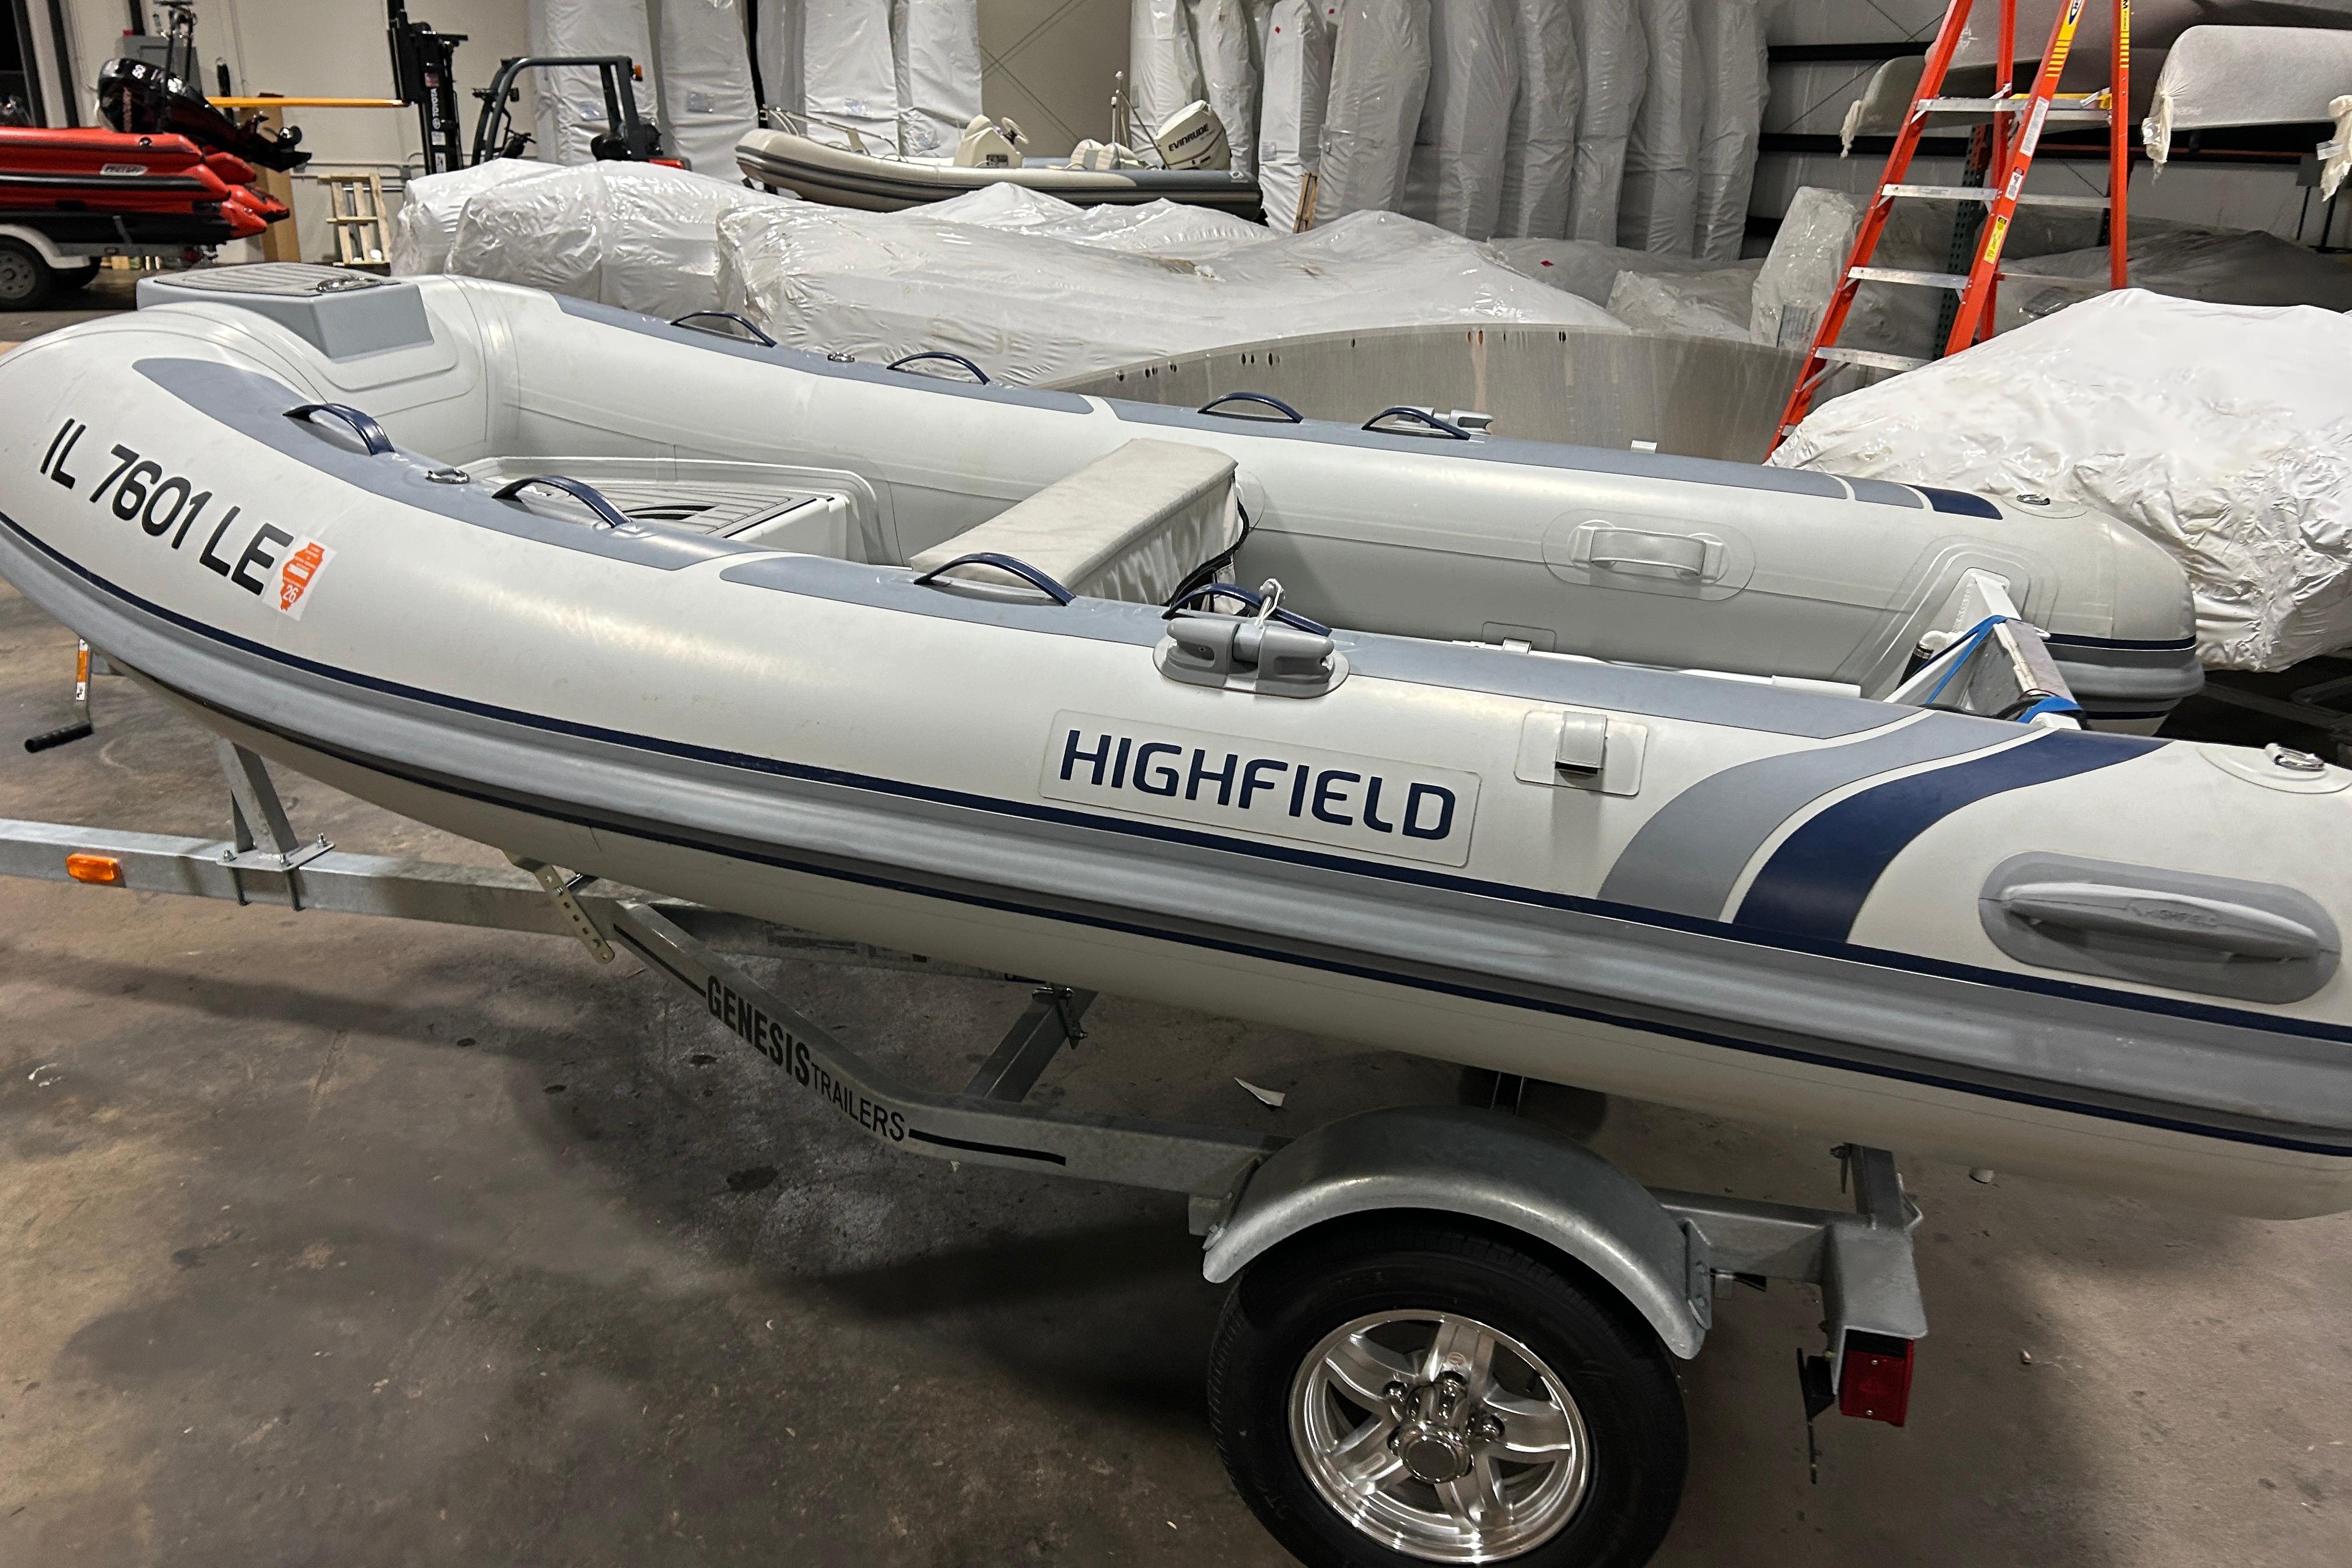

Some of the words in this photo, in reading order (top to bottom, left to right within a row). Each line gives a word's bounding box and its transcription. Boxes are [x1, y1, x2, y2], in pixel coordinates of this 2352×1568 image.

[430, 88, 439, 117] TOYOTA
[1168, 124, 1209, 152] EVINRUDE
[40, 418, 86, 489] IL
[89, 443, 213, 550] 7601
[199, 505, 294, 596] LE
[283, 584, 299, 603] 26
[1059, 729, 1456, 841] HIGHFIELD
[708, 975, 810, 1087] GENESIS
[811, 1061, 905, 1142] TRAILERS
